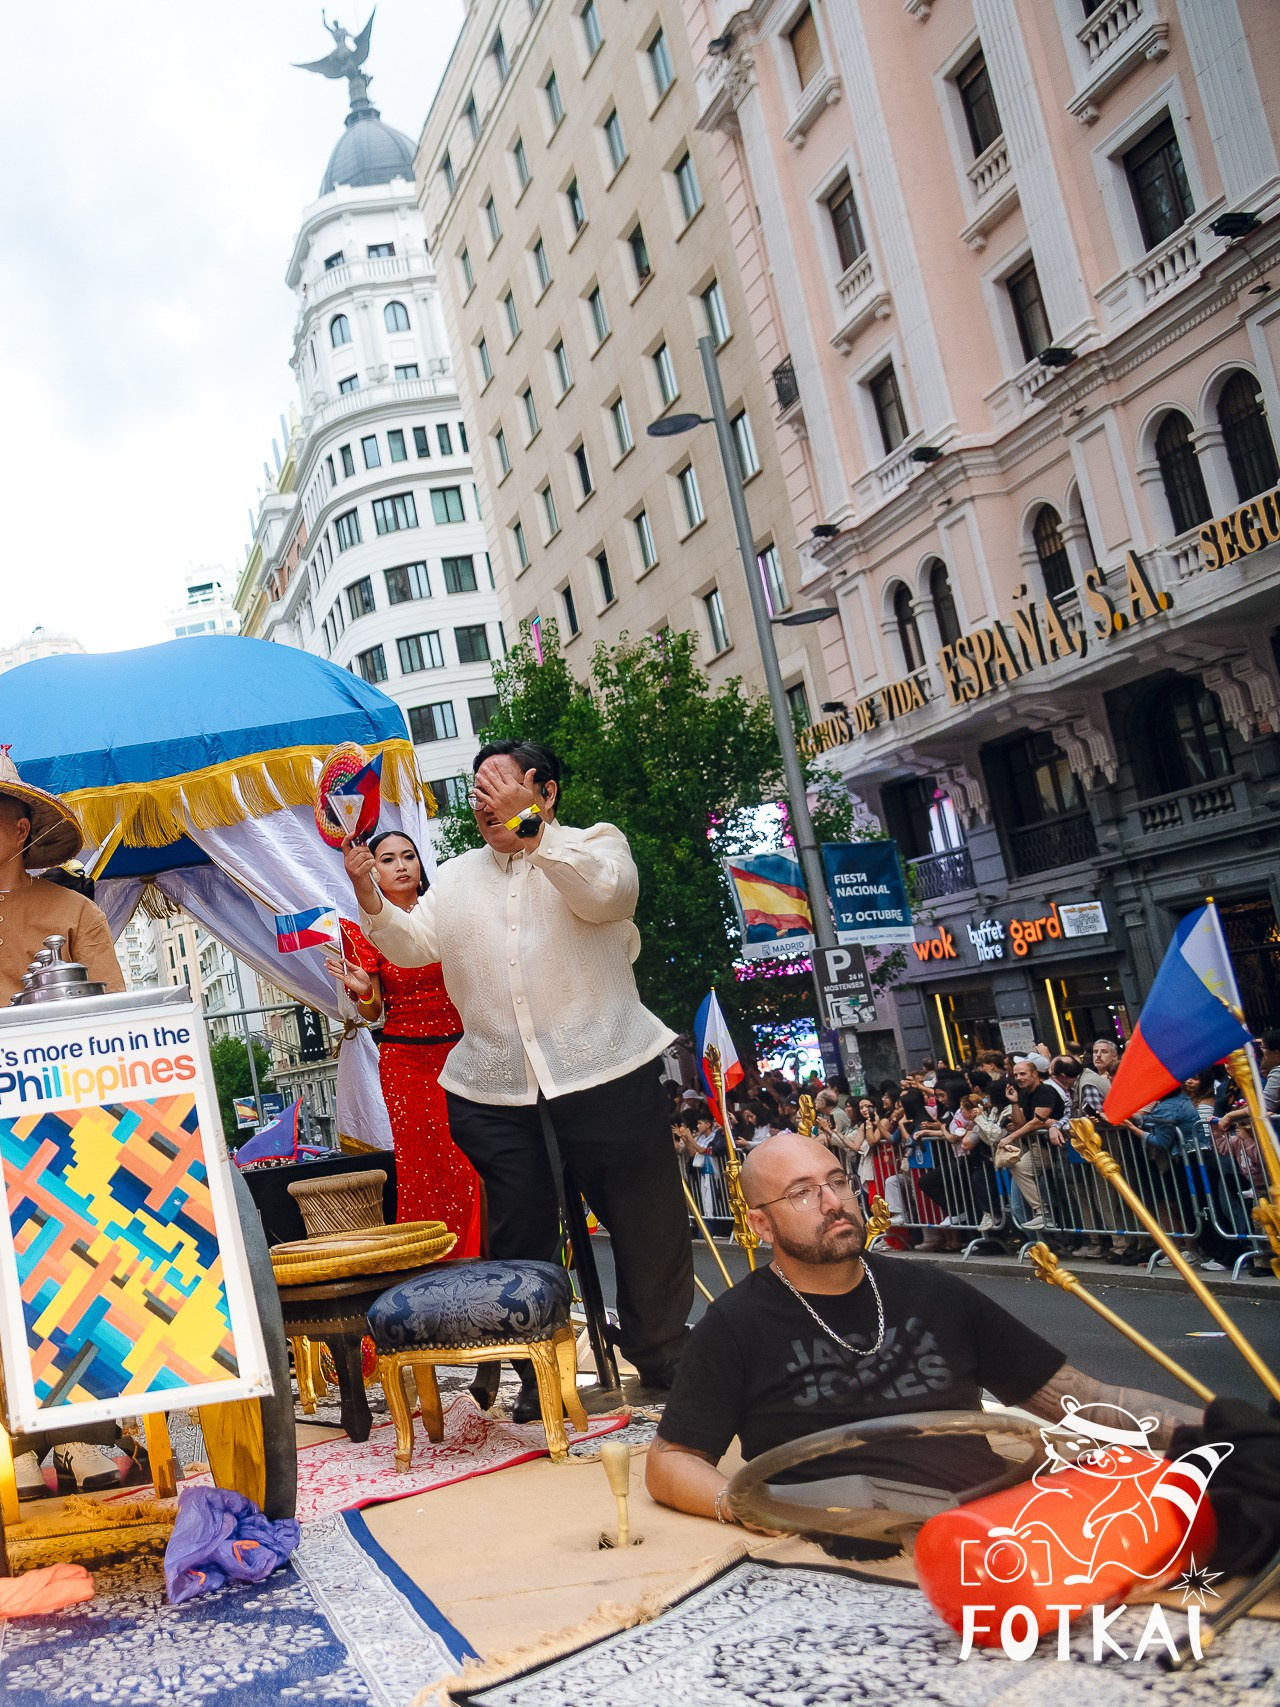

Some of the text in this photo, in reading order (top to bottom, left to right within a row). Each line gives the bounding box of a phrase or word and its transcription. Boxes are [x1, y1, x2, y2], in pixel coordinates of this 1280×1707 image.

[852, 698, 878, 736] DE
[881, 675, 928, 721] VIDA
[1085, 550, 1173, 640] S.A.
[834, 873, 867, 885] FIESTA
[836, 885, 890, 897] NACIONAL
[840, 909, 903, 923] 12 OCTUBRE
[966, 919, 1005, 944] buffet
[772, 941, 804, 953] MADRID
[912, 925, 957, 961] wok
[975, 942, 1004, 961] libre
[824, 948, 851, 983] P
[823, 981, 865, 992] MOSTENSES
[23, 1041, 83, 1065] more
[88, 1036, 124, 1056] fun
[128, 1031, 149, 1050] in
[153, 1027, 190, 1047] the
